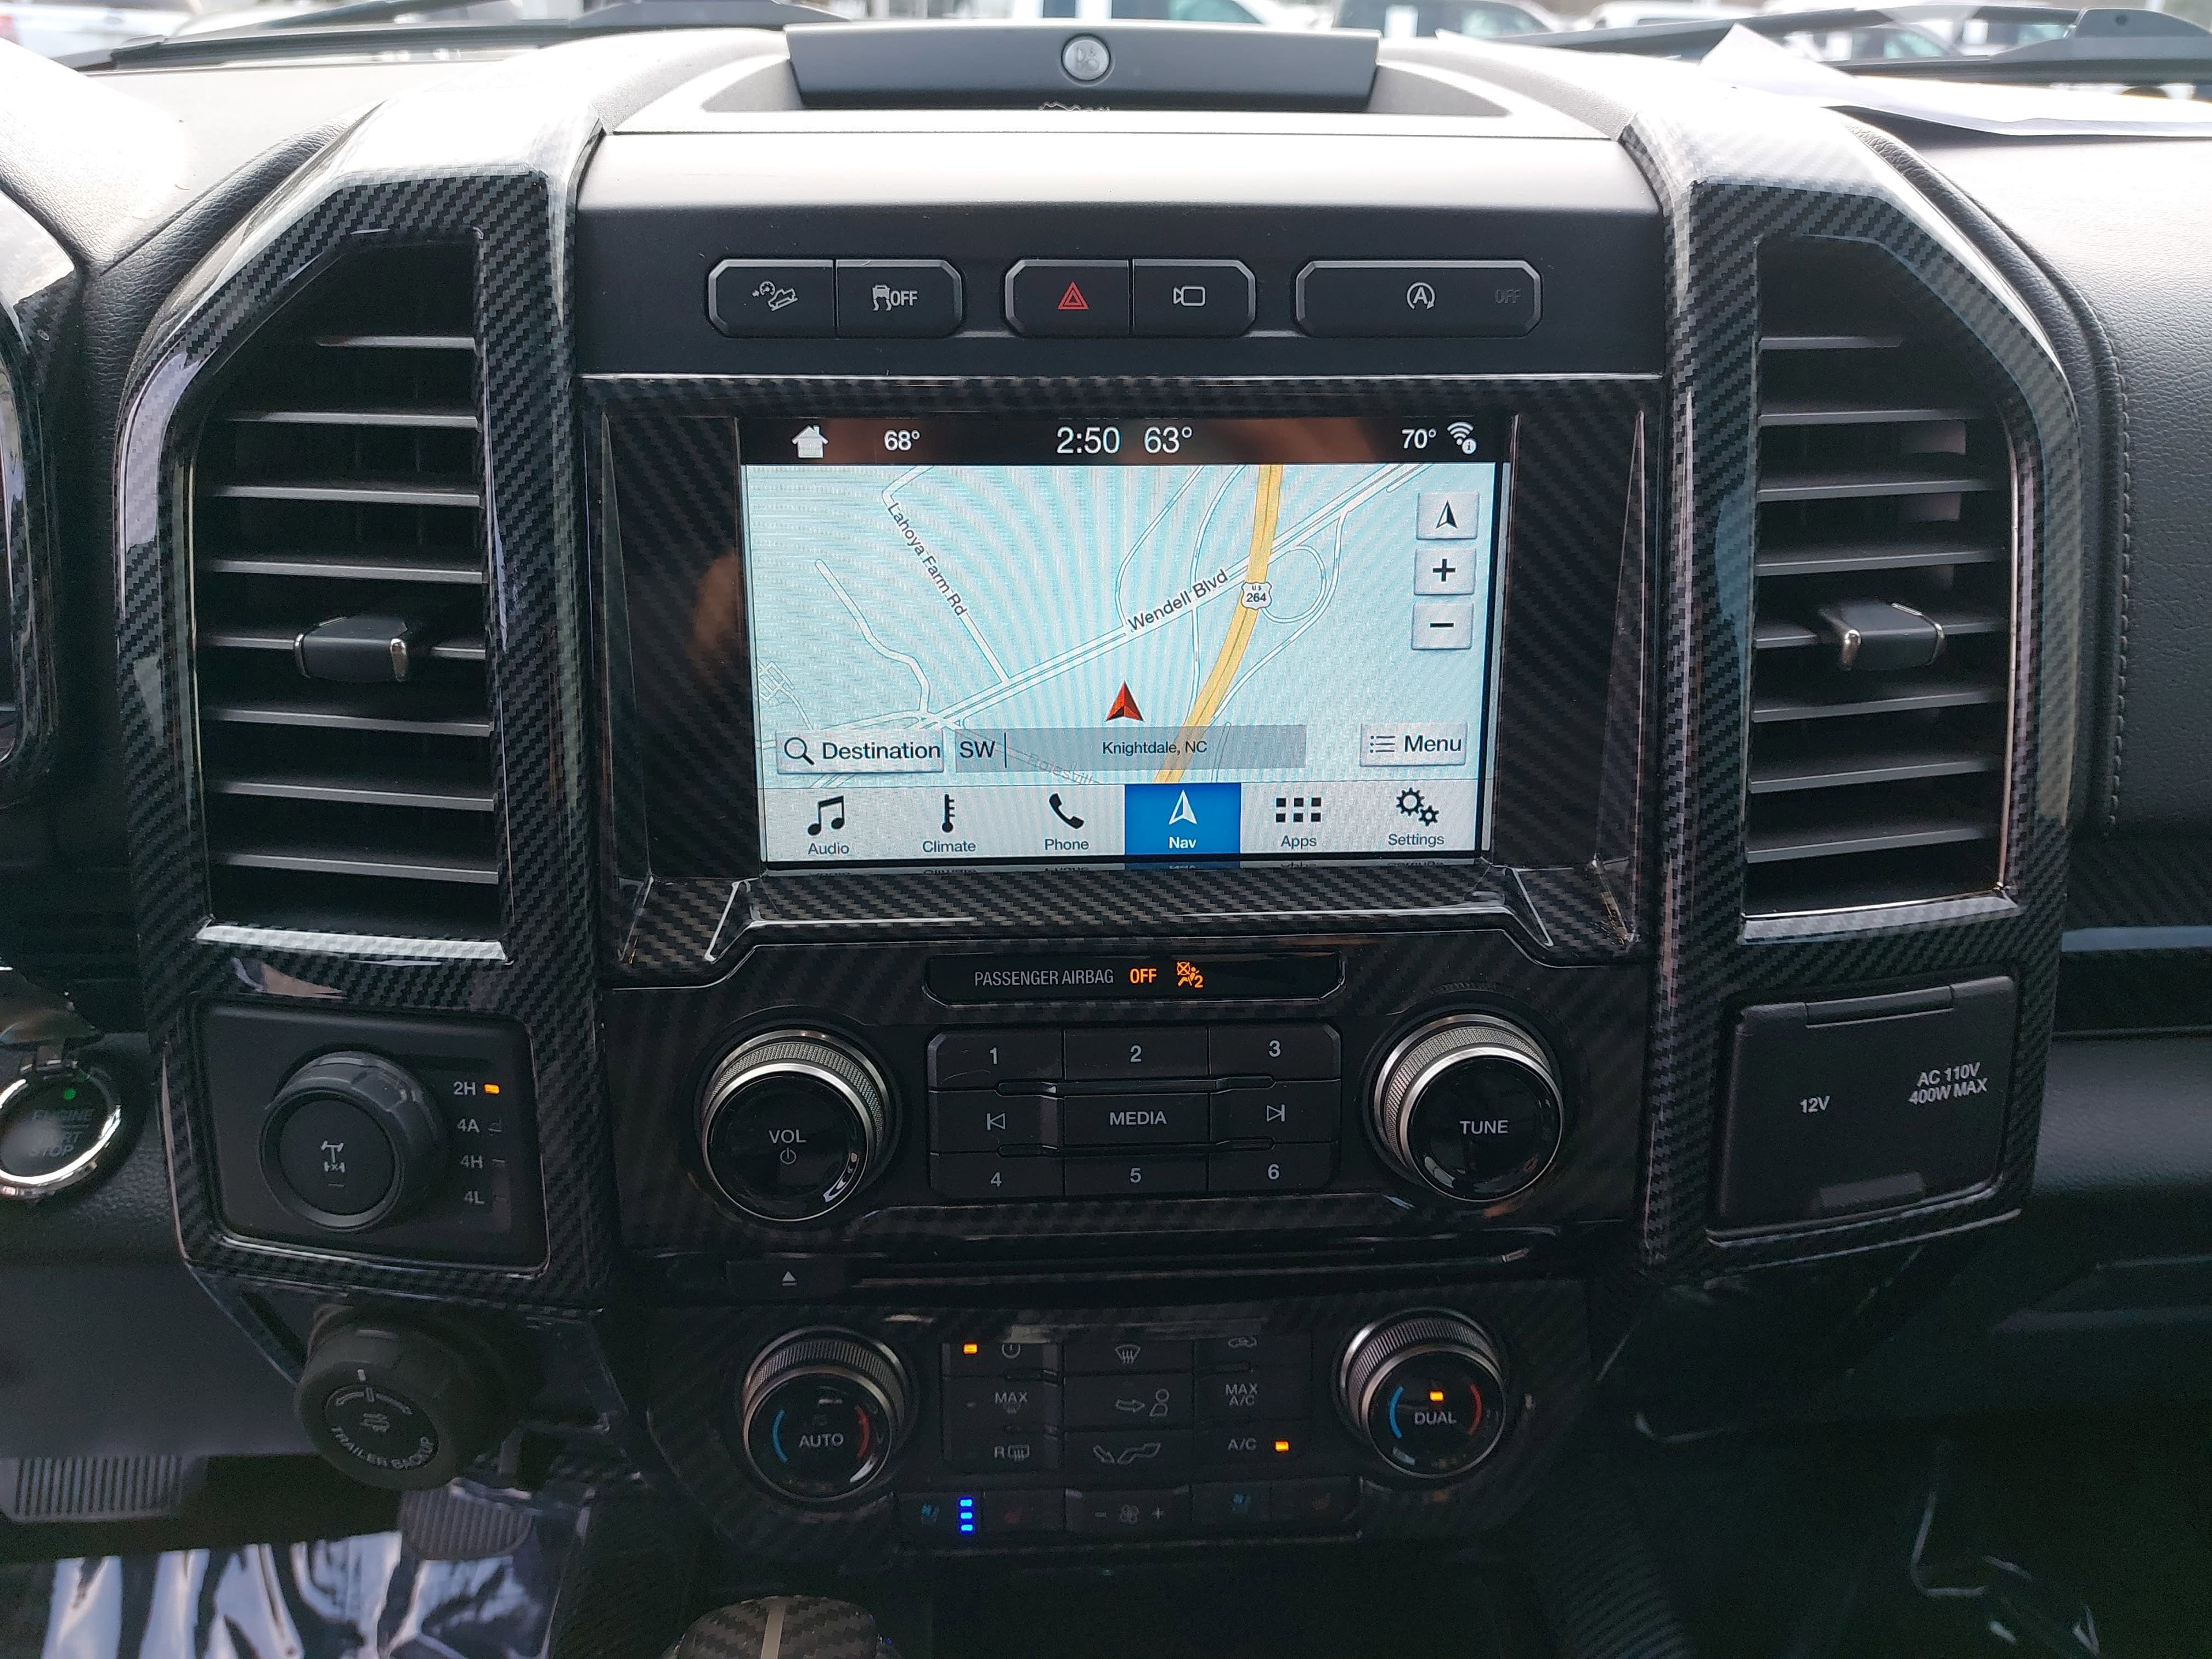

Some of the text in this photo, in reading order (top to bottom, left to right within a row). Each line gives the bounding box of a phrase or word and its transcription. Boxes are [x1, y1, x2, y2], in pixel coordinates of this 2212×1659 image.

[891, 290, 918, 307] OFF
[1495, 289, 1521, 303] OFF
[884, 431, 920, 451] 68°
[1057, 427, 1120, 454] 2:50
[1144, 427, 1193, 454] 63°
[1401, 428, 1437, 449] 70°
[887, 503, 968, 616] Lahoya Farm Rd
[1127, 569, 1229, 631] Wendell Blvd
[1246, 592, 1267, 602] 264
[822, 742, 941, 760] Destination
[959, 741, 996, 758] SW
[1102, 741, 1207, 755] Knightdale, NC
[1404, 736, 1462, 752] Menu
[922, 840, 977, 854] Climate
[1045, 838, 1089, 851] Phone
[1169, 836, 1197, 849] Nav
[1280, 834, 1317, 849] Apps
[1387, 833, 1444, 847] Settings
[808, 842, 850, 855] Audio
[974, 968, 1157, 986] PASSENGER AIRBAG OFF
[990, 1047, 998, 1064] 1
[1130, 1046, 1142, 1063] 2
[1268, 1040, 1282, 1058] 3
[1917, 1062, 1981, 1087] AC 110V
[453, 1081, 476, 1096] 2H
[1908, 1077, 1988, 1105] 400W MAX
[1800, 1096, 1830, 1113] 12V
[457, 1119, 480, 1133] 4A
[1109, 1111, 1167, 1126] MEDIA
[1459, 1120, 1509, 1135] TUNE
[769, 1129, 806, 1144] VOL
[460, 1156, 483, 1170] 4H
[990, 1172, 1002, 1187] 4
[1130, 1168, 1142, 1183] 5
[1267, 1164, 1280, 1180] 6
[463, 1191, 485, 1205] 4L
[1225, 1383, 1259, 1395] MAX
[994, 1391, 1028, 1404] MAX
[1229, 1395, 1256, 1407] A/C
[1414, 1411, 1457, 1426] DUAL
[798, 1433, 844, 1448] AUTO
[1228, 1438, 1257, 1451] A/C
